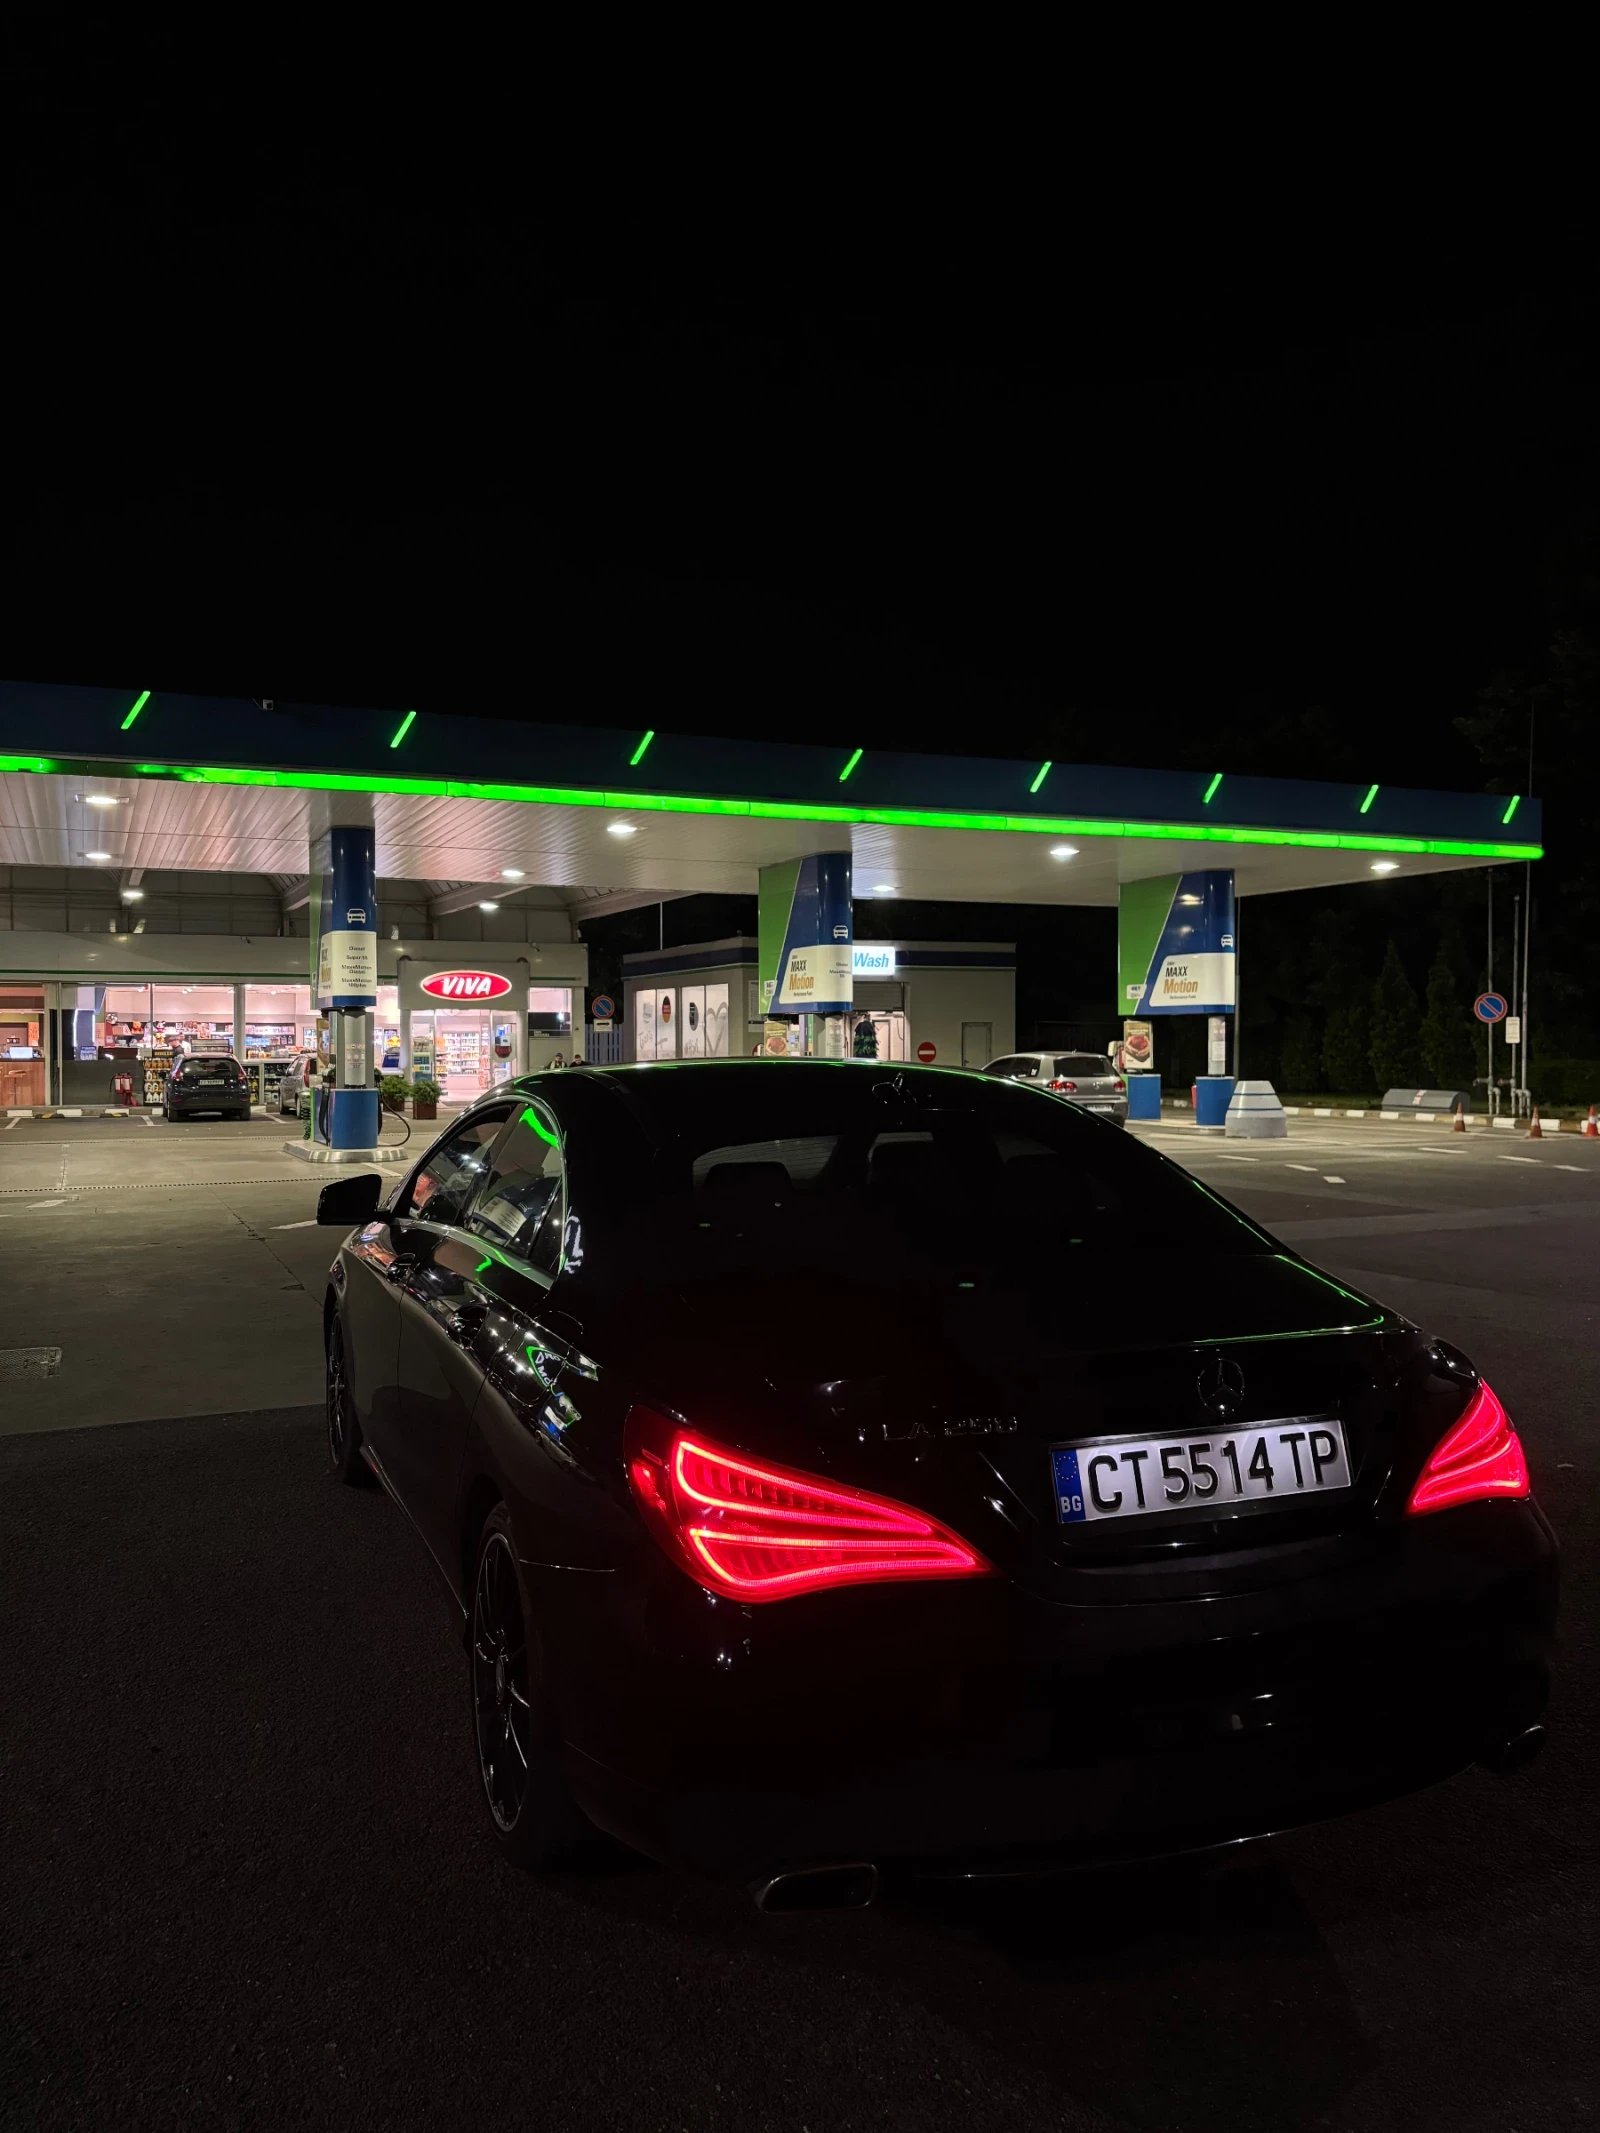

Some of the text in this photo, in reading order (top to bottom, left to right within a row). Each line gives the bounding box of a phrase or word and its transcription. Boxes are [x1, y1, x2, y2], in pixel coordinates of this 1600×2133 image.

[791, 960, 807, 972] MAXX
[854, 952, 889, 968] Wash
[1165, 966, 1188, 977] MAXX
[441, 976, 492, 995] VIVA
[789, 974, 814, 990] Motion
[1163, 979, 1198, 993] Motion
[1088, 1429, 1338, 1513] CT 5514 TP
[1060, 1495, 1082, 1514] BG
